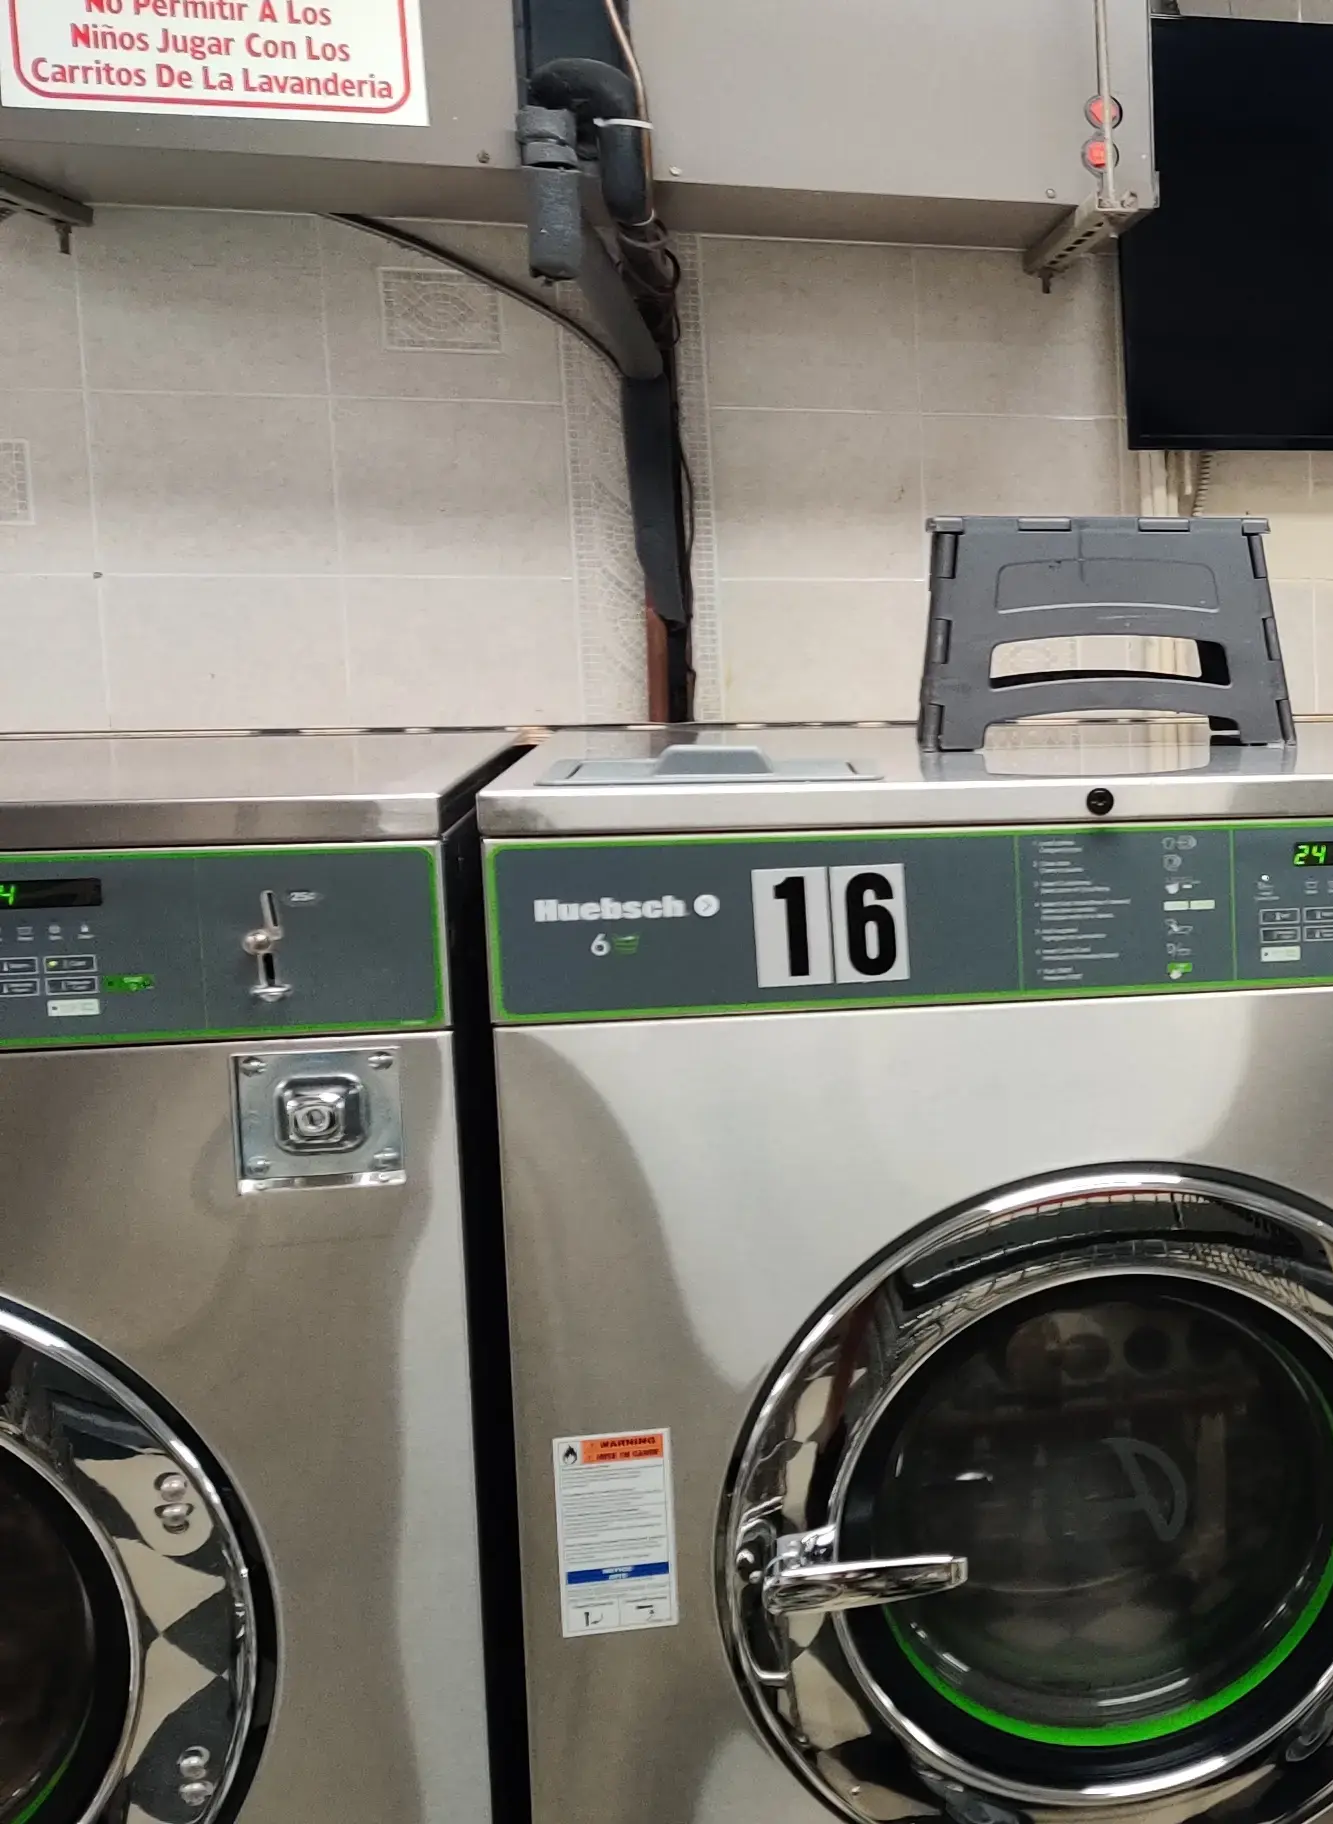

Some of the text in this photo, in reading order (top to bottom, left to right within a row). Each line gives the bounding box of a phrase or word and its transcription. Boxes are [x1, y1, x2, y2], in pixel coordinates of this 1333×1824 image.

[85, 0, 332, 26] No Permitir A Los
[70, 23, 350, 62] Niños Jugar Con Los
[31, 57, 393, 99] Carritos De La Lavanderia
[1294, 845, 1327, 865] 24
[534, 895, 688, 922] Huebsch
[773, 872, 897, 977] 16
[590, 933, 611, 957] 6
[600, 1436, 656, 1449] WARNING
